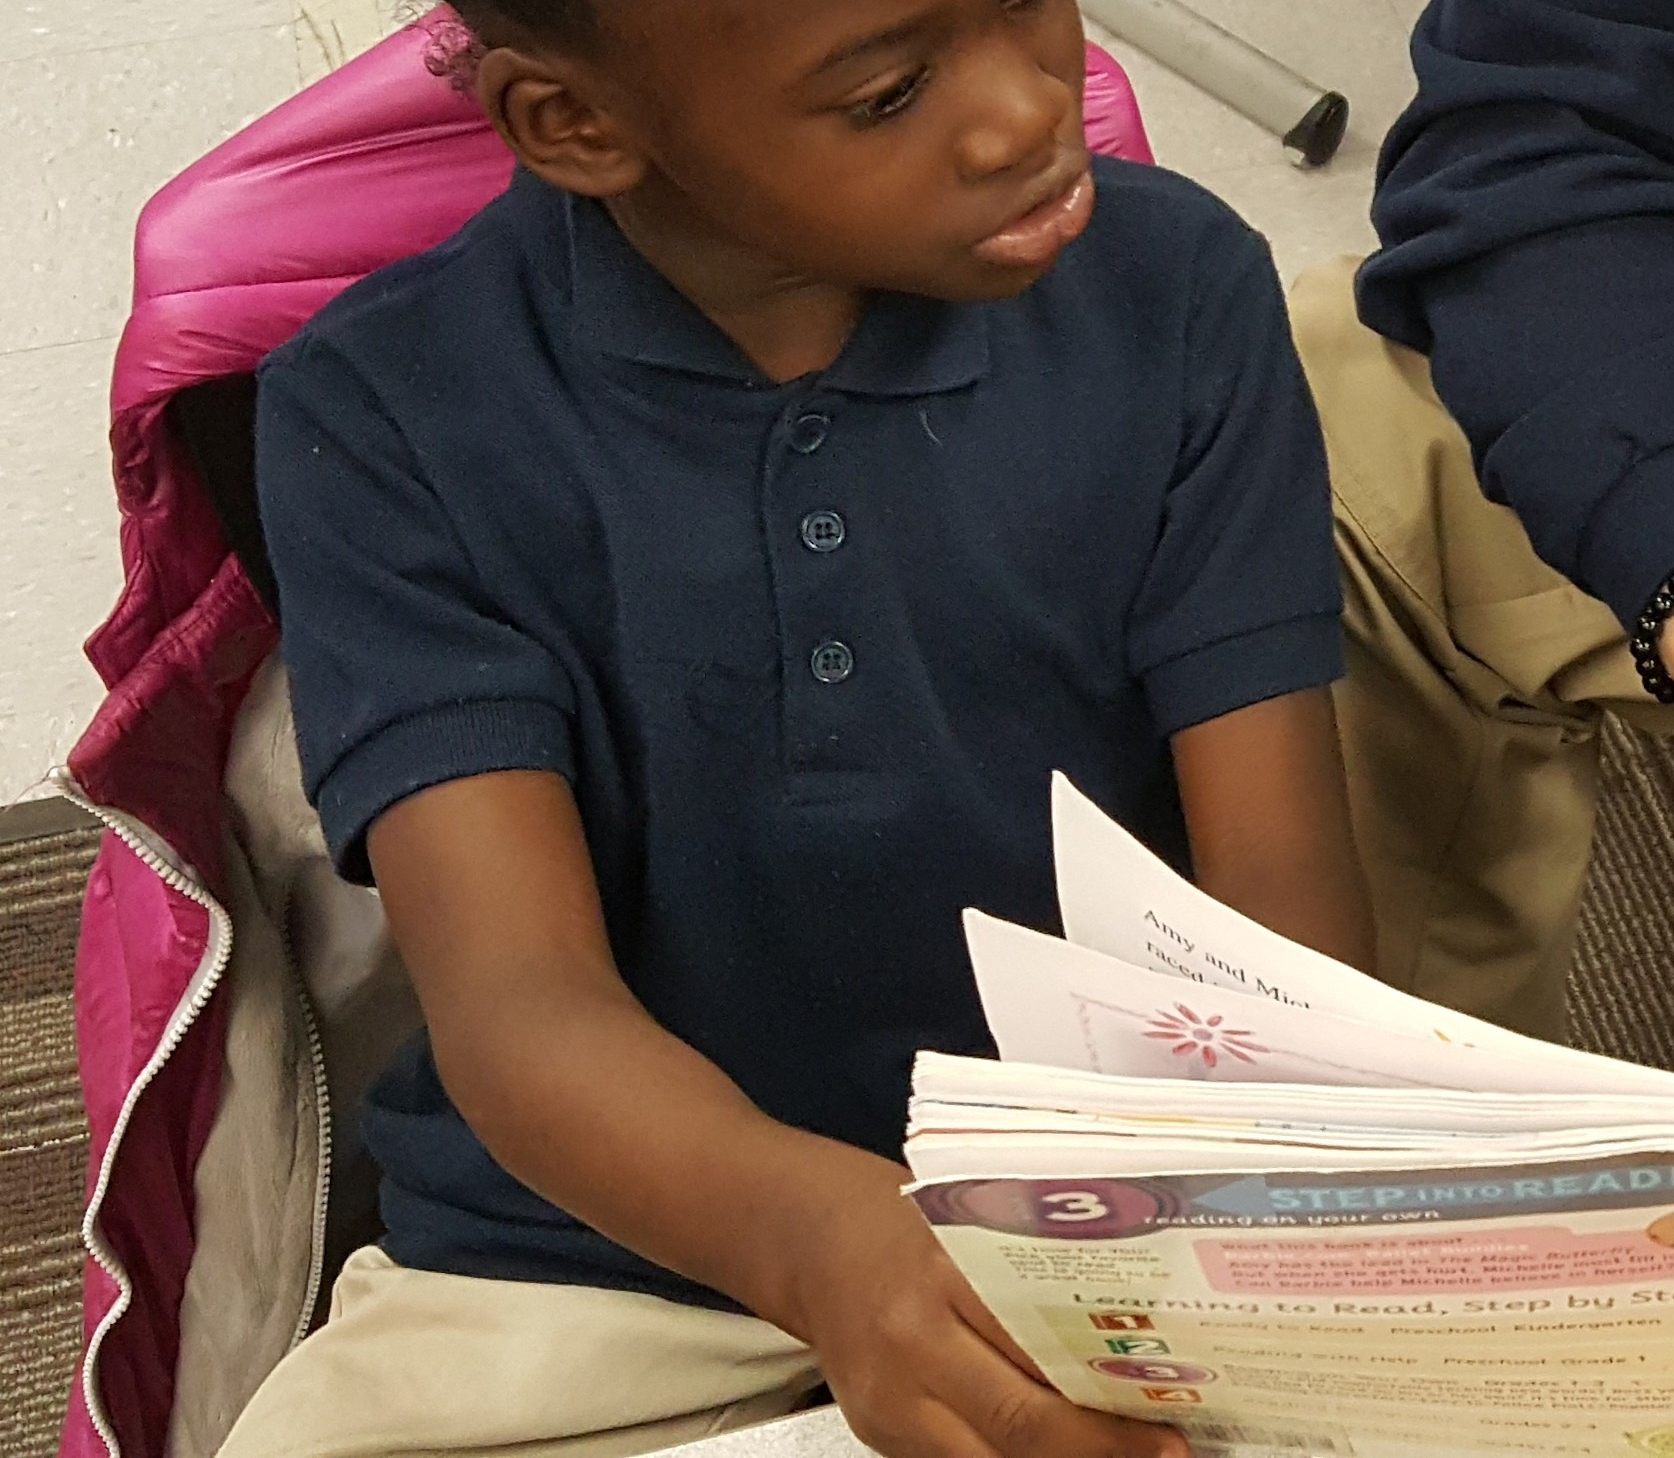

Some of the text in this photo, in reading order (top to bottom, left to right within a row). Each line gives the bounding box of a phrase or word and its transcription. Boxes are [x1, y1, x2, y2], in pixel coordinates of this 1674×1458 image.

[1144, 909, 1195, 953] Amy
[1205, 952, 1246, 983] and
[1041, 1190, 1109, 1222] 3
[1268, 1186, 1405, 1213] STEP
[1144, 1209, 1441, 1228] reading on your own
[1072, 1293, 1260, 1314] Learning
[1276, 1302, 1317, 1313] to
[1333, 1301, 1449, 1317] Read,
[1463, 1298, 1552, 1313] Step
[1567, 1295, 1615, 1310] by
